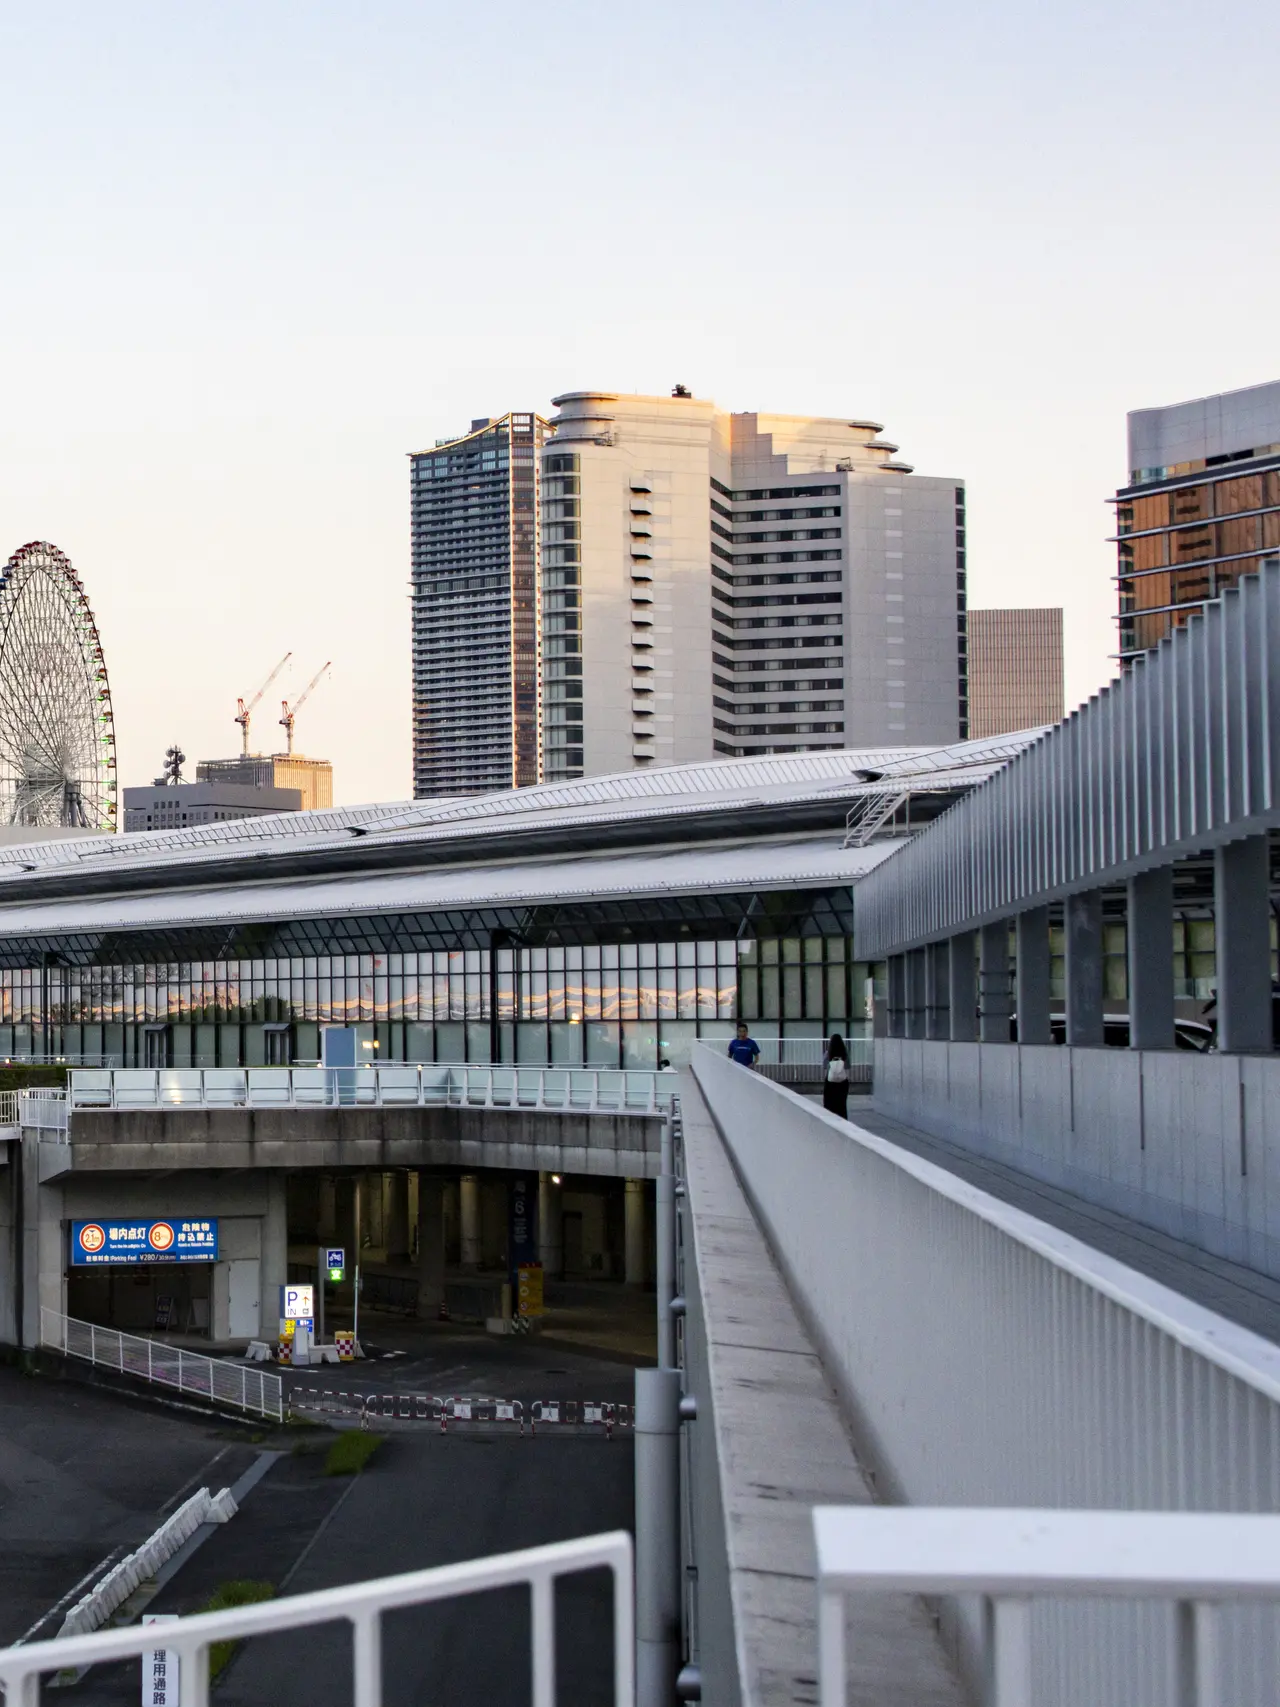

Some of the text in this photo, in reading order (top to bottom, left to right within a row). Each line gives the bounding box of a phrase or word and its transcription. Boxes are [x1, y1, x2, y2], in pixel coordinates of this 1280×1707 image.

[109, 1227, 146, 1240] 場内点灯
[288, 1291, 298, 1306] P
[287, 1308, 297, 1316] IN
